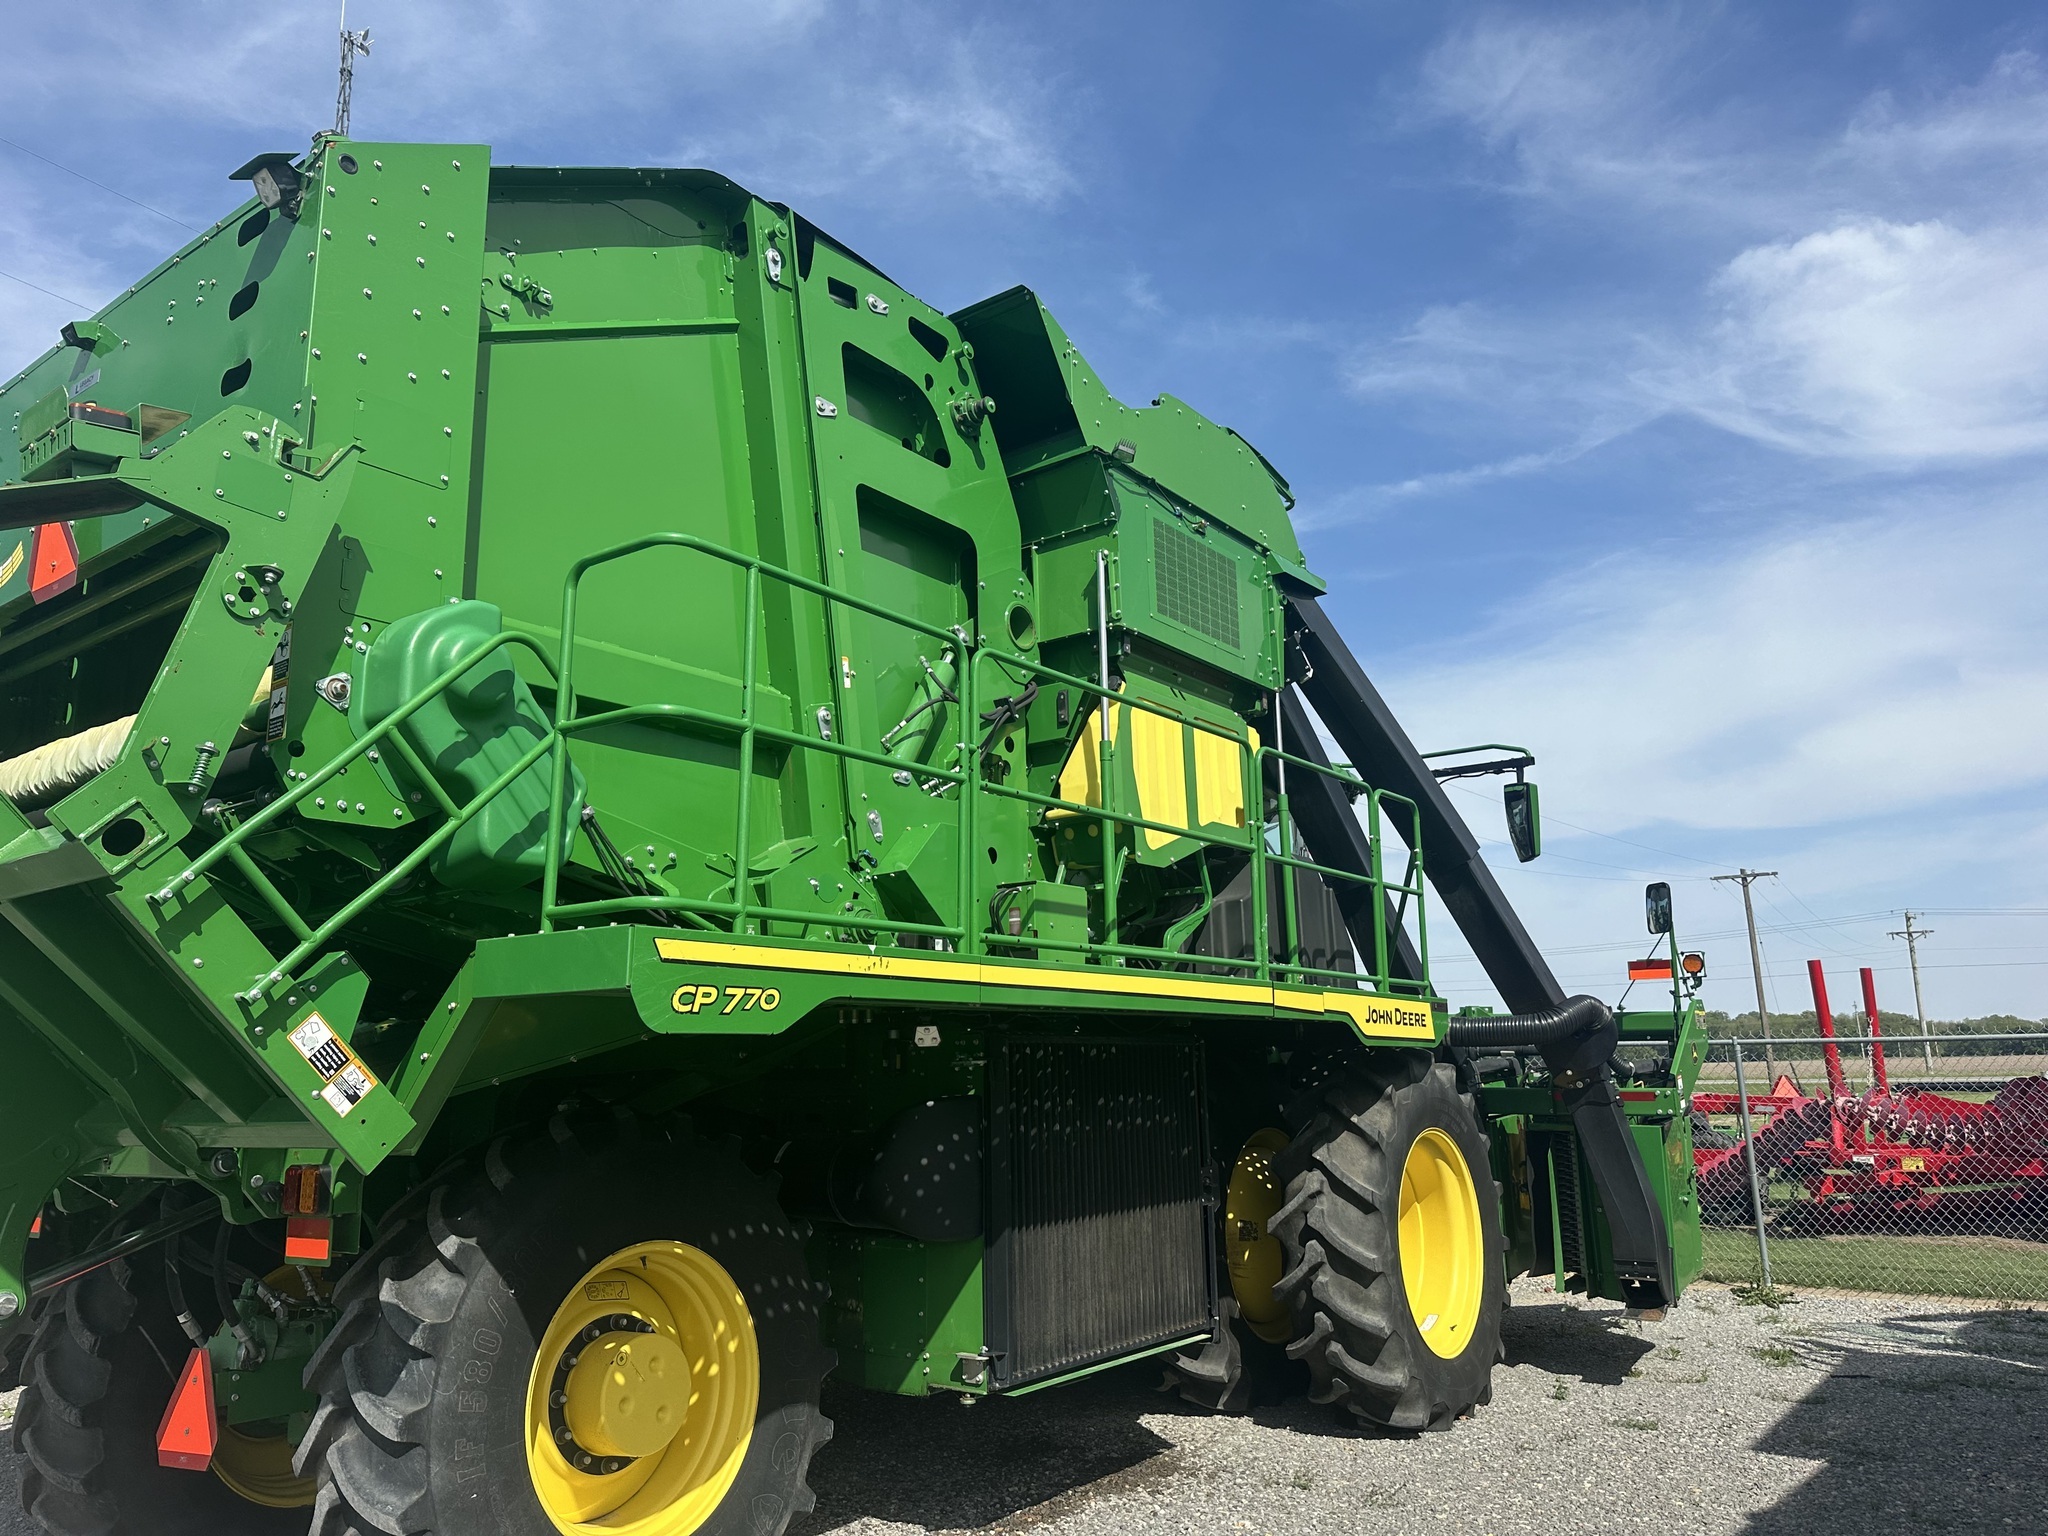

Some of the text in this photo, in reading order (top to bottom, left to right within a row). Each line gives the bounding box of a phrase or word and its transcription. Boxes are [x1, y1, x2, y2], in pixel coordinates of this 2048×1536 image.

[671, 983, 781, 1015] CP 770
[1365, 1005, 1427, 1027] JOHN DEERE
